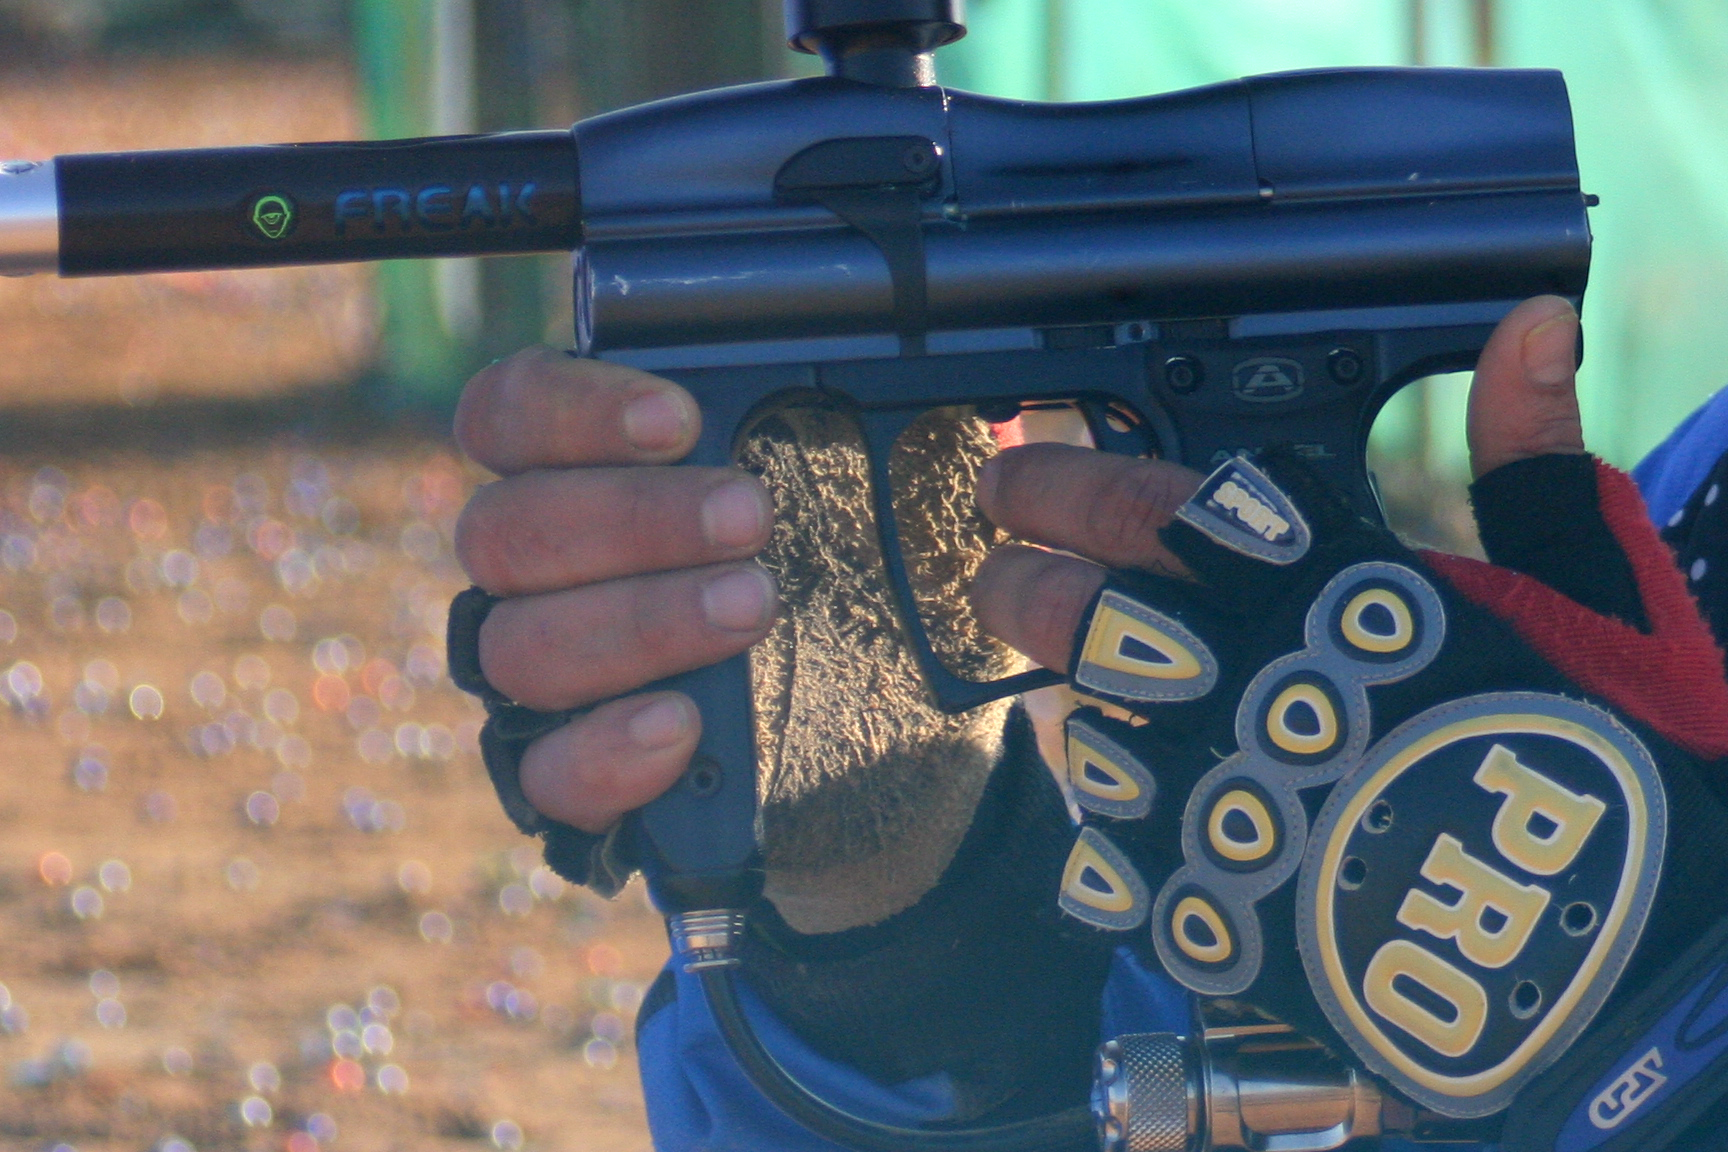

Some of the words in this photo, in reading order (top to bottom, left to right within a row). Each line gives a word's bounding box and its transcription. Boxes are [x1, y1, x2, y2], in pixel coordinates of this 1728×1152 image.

[334, 182, 538, 236] FREAK
[1213, 481, 1290, 541] SPORT
[1363, 743, 1607, 1057] PRO
